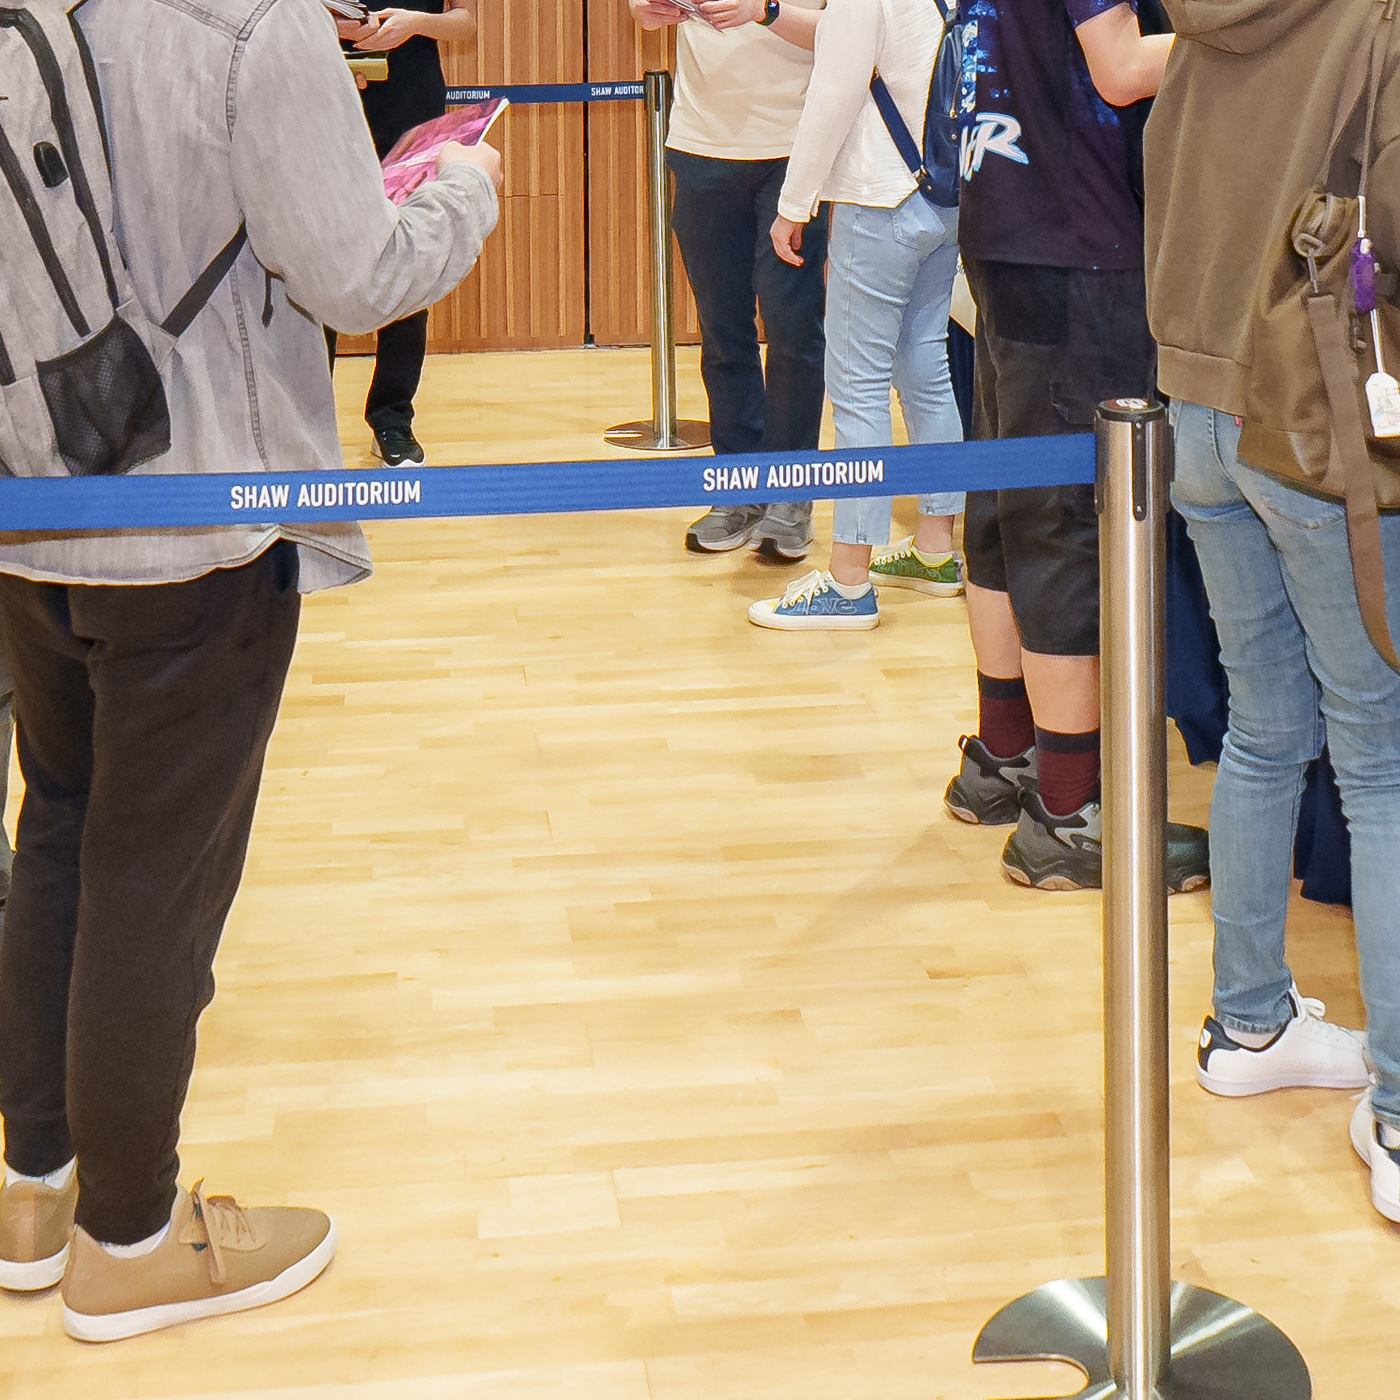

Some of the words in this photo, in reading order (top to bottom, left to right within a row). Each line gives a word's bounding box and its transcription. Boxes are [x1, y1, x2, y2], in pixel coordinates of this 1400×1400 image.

[445, 90, 491, 100] AUDITORIUM
[591, 86, 612, 96] SHAW
[703, 466, 759, 492] SHAW
[766, 459, 884, 489] AUDITORIUM
[230, 484, 290, 510] SHAW
[297, 480, 422, 508] AUDITORIUM
